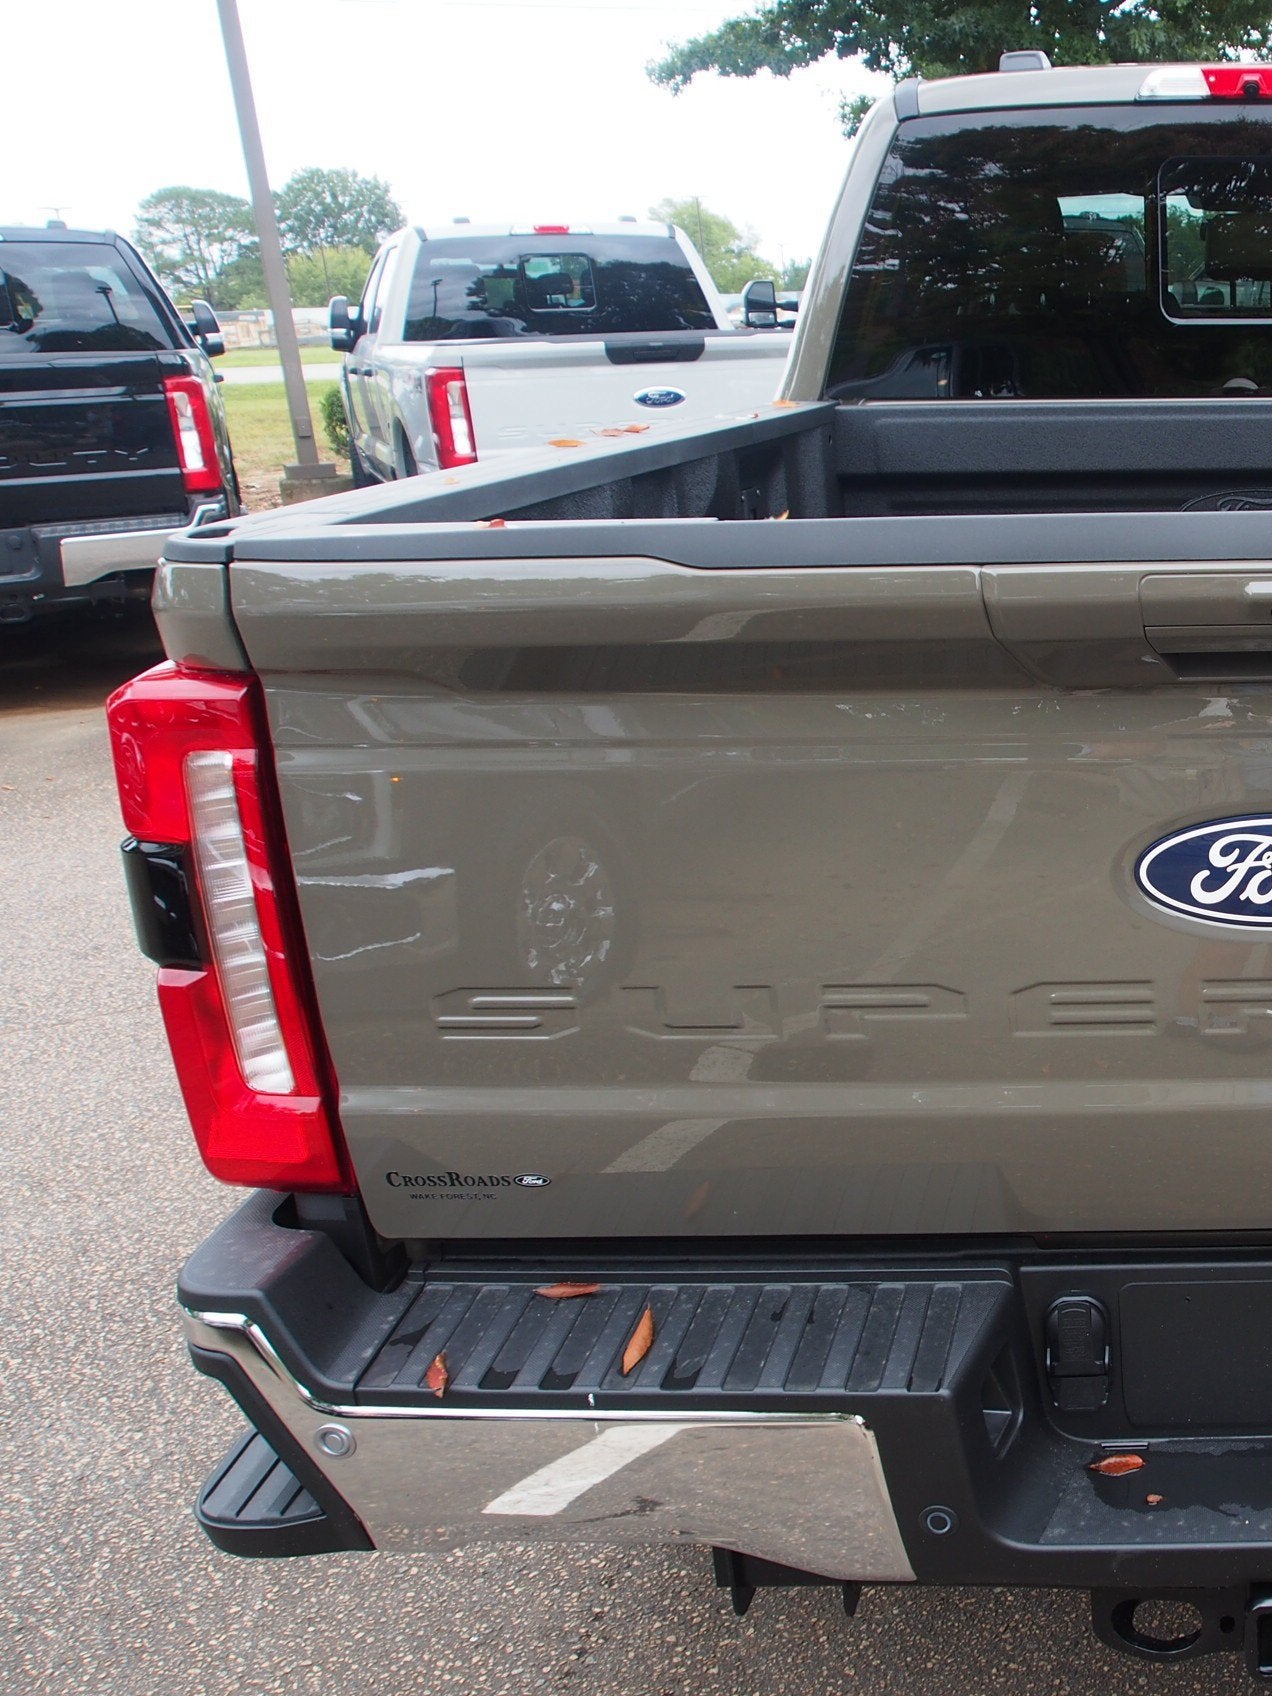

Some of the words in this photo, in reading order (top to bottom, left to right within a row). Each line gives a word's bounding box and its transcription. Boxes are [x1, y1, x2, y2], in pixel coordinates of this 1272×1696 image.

[409, 1192, 438, 1200] WAKE
[440, 1192, 481, 1201] FOREST,
[483, 1192, 497, 1200] NC
